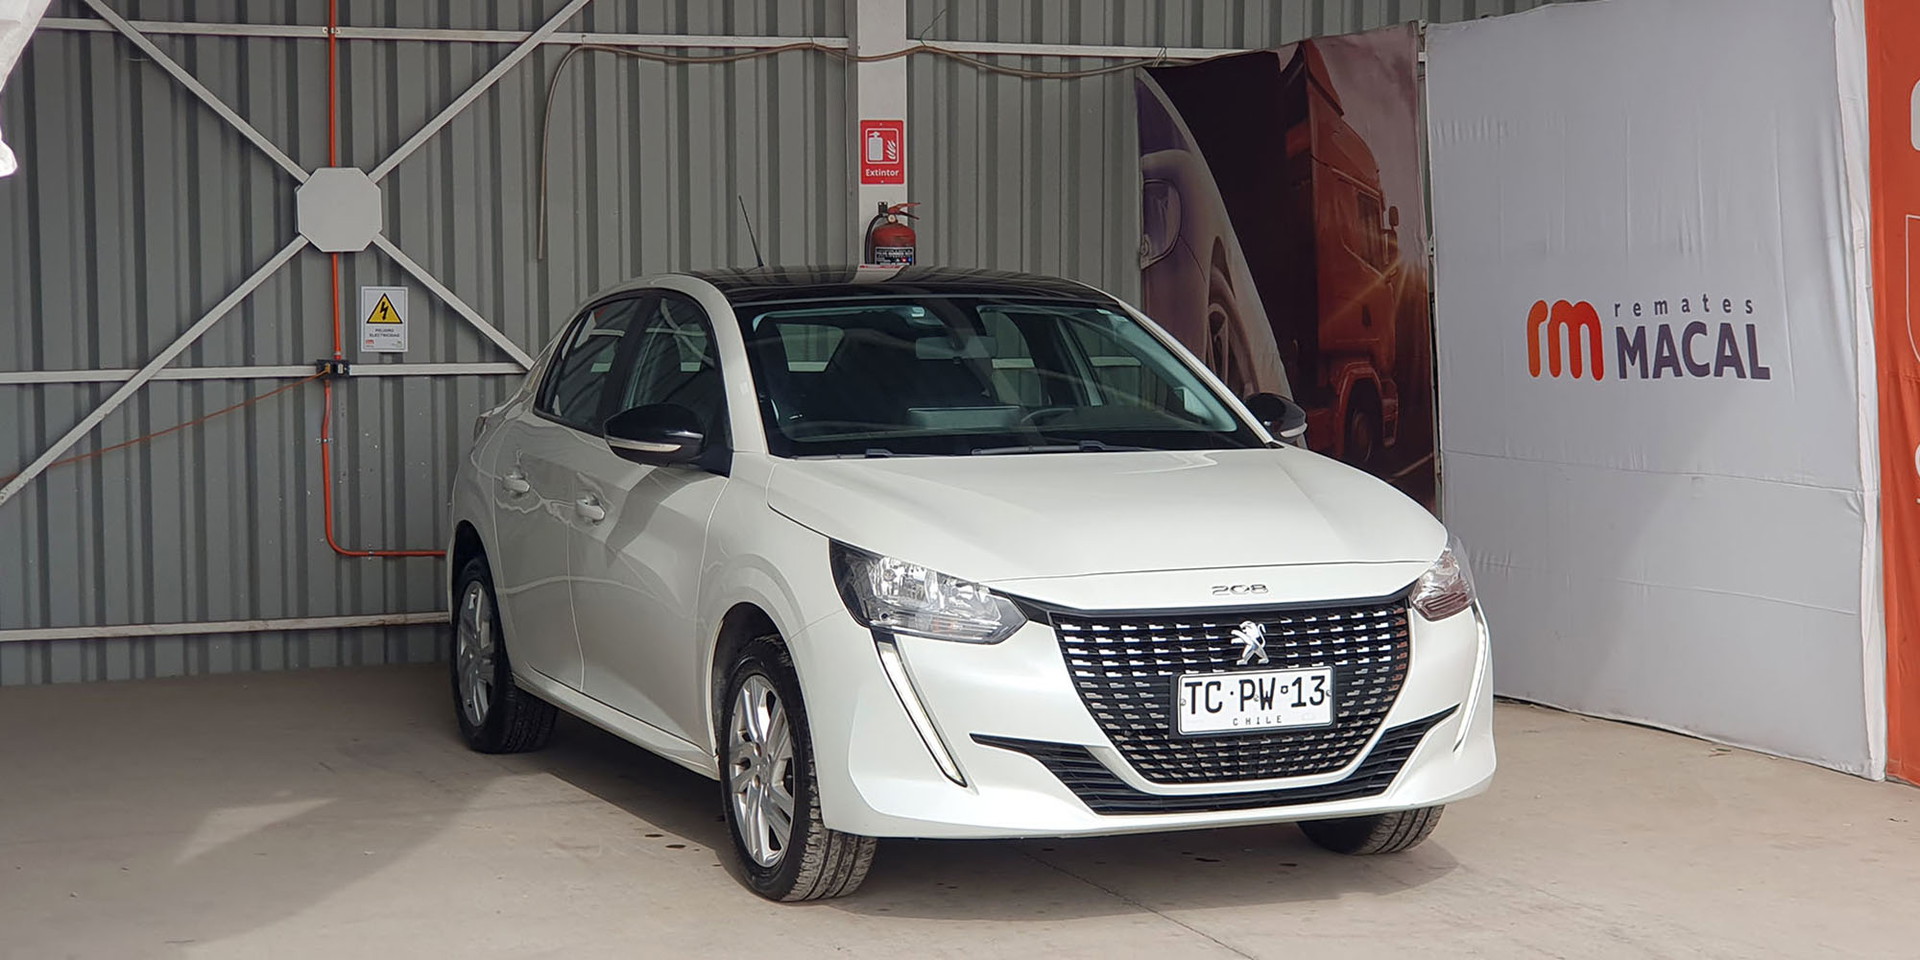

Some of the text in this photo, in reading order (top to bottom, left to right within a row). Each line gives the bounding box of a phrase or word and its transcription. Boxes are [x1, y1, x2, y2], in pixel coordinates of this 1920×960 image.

[866, 169, 899, 177] Extintor
[1614, 294, 1753, 317] remates
[1617, 321, 1771, 380] MACAL
[1212, 584, 1268, 595] 208
[1233, 716, 1282, 726] CHILE
